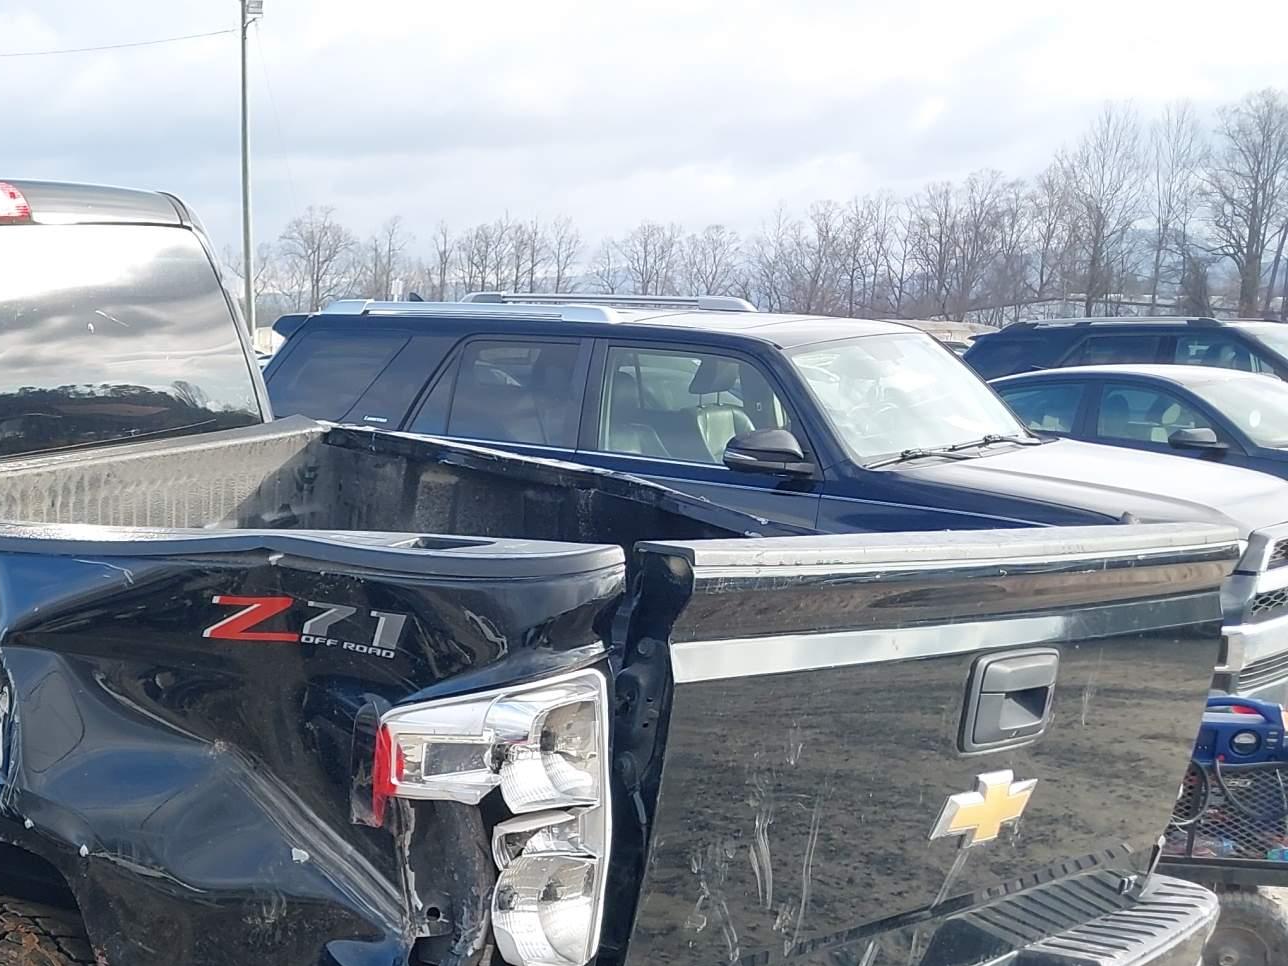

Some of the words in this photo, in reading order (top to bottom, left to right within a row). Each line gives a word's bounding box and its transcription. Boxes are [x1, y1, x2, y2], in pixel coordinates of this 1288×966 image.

[202, 595, 408, 650] Z71
[300, 634, 339, 647] OFF
[342, 641, 396, 659] ROAD
